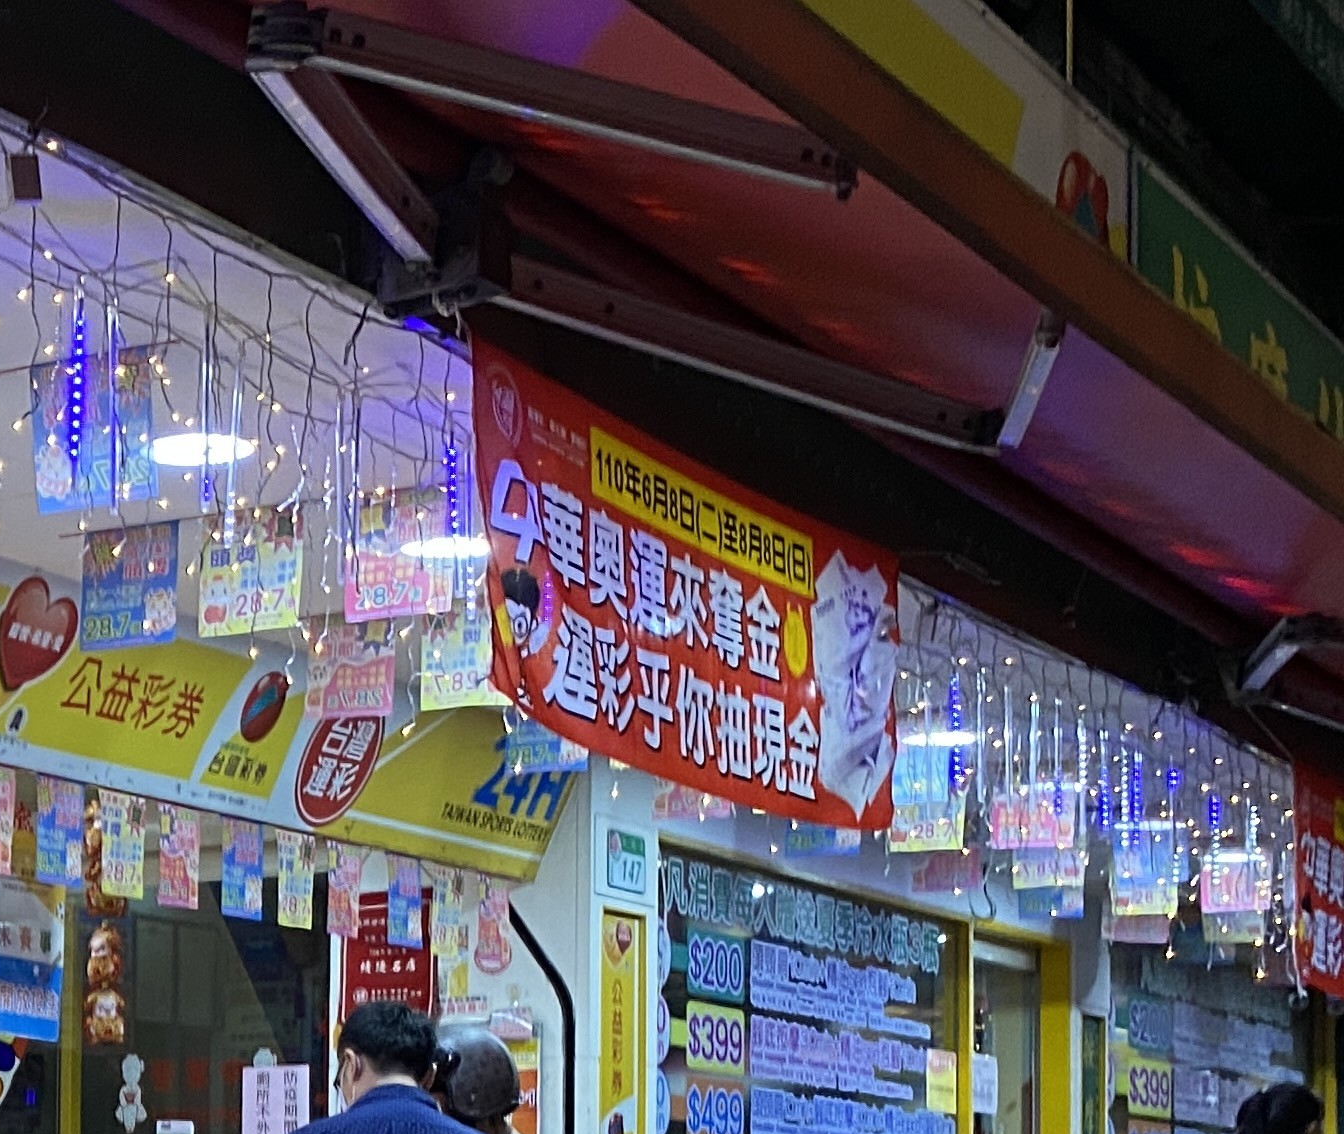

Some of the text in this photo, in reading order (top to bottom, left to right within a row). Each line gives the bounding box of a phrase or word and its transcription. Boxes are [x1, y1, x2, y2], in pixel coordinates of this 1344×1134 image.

[489, 458, 783, 683] 中華奧運來奪金
[60, 657, 206, 740] 公益彩券
[543, 604, 819, 803] 運彩乎你抽現金
[441, 802, 479, 826] TAIWAN
[689, 934, 744, 993] $200
[688, 1012, 743, 1066] $399
